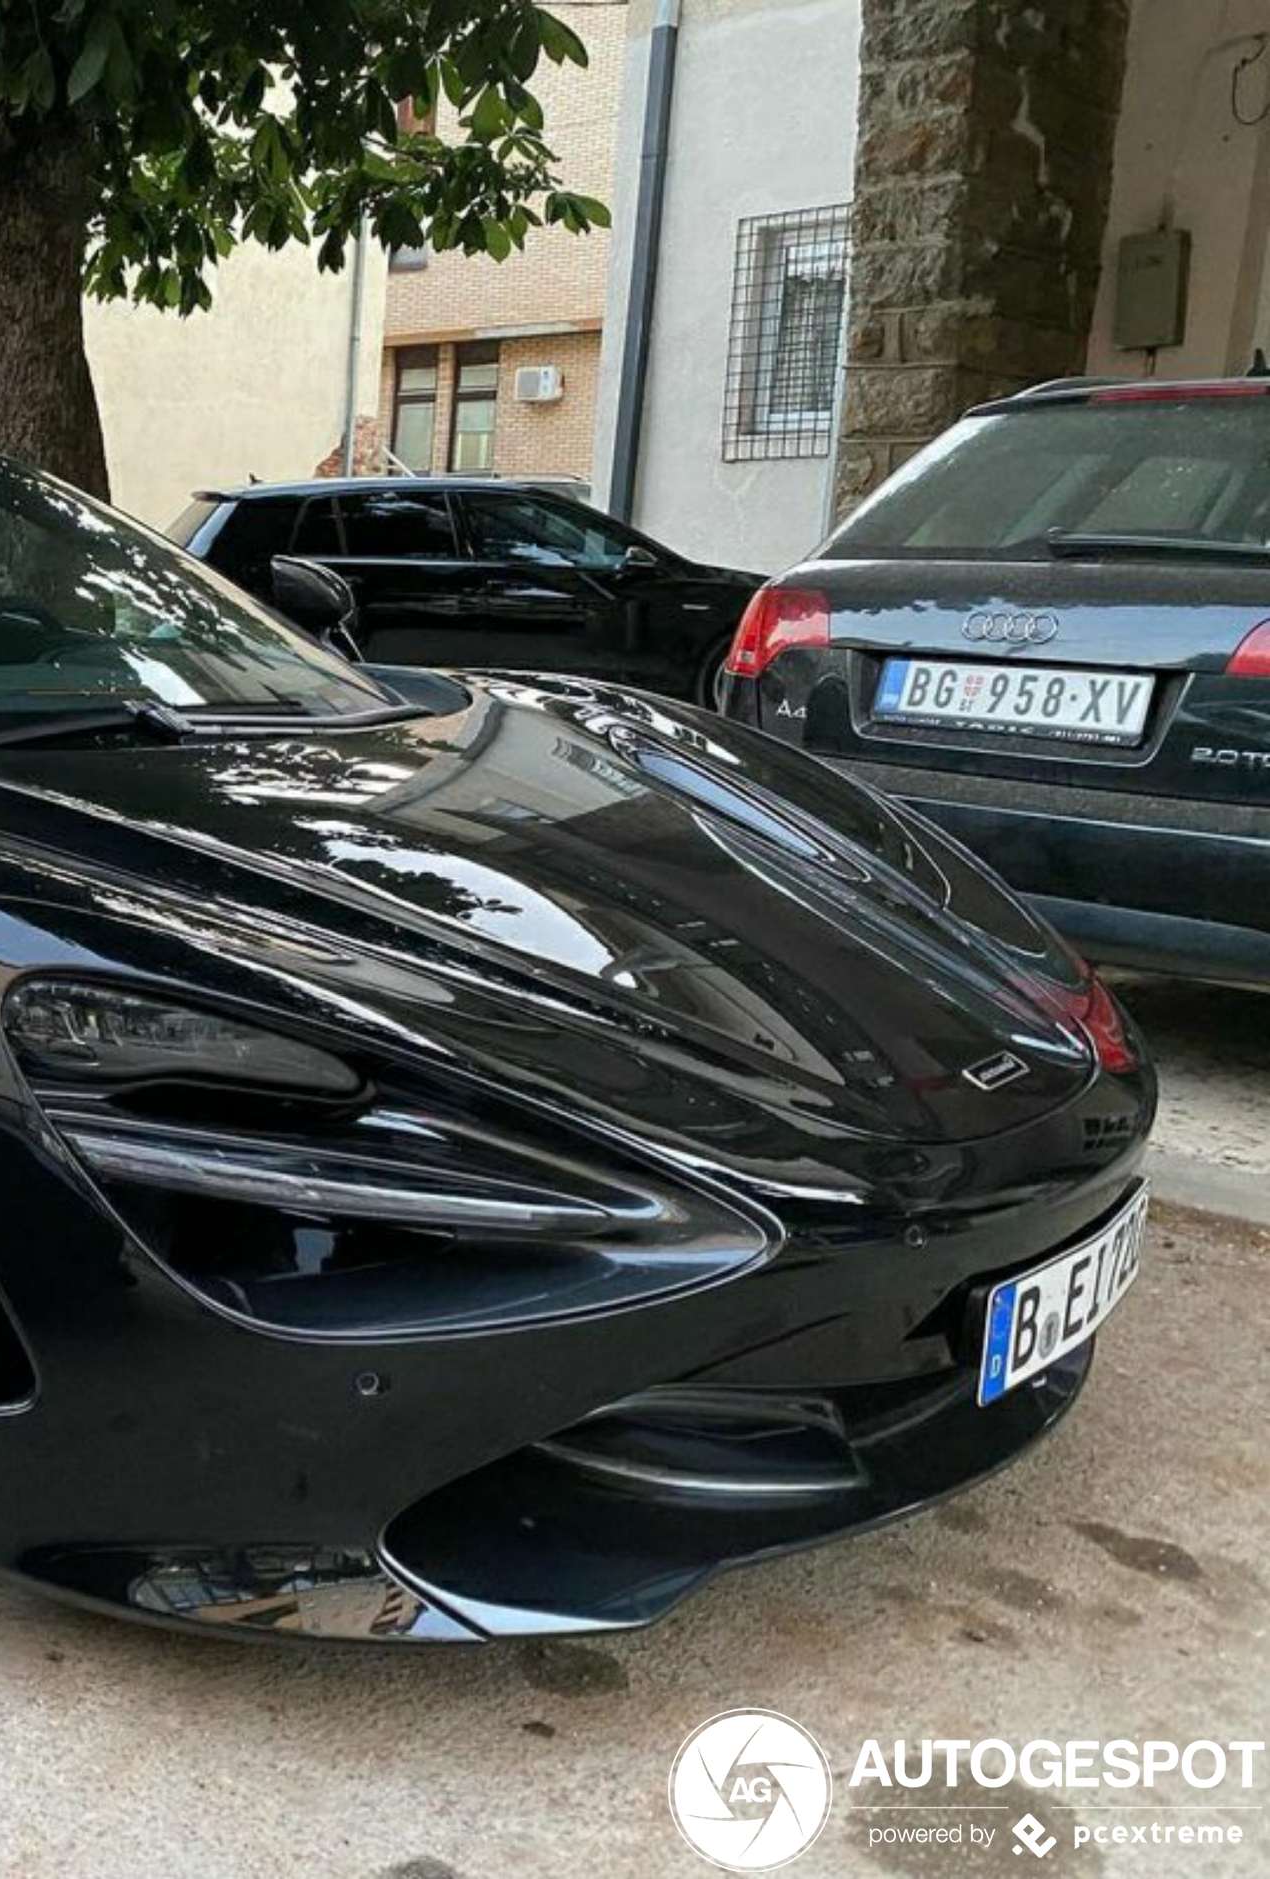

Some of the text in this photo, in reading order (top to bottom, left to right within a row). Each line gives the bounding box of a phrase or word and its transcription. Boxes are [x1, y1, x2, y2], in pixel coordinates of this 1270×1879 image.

[907, 668, 958, 708] BG
[776, 699, 807, 718] A4
[1011, 1286, 1041, 1373] B
